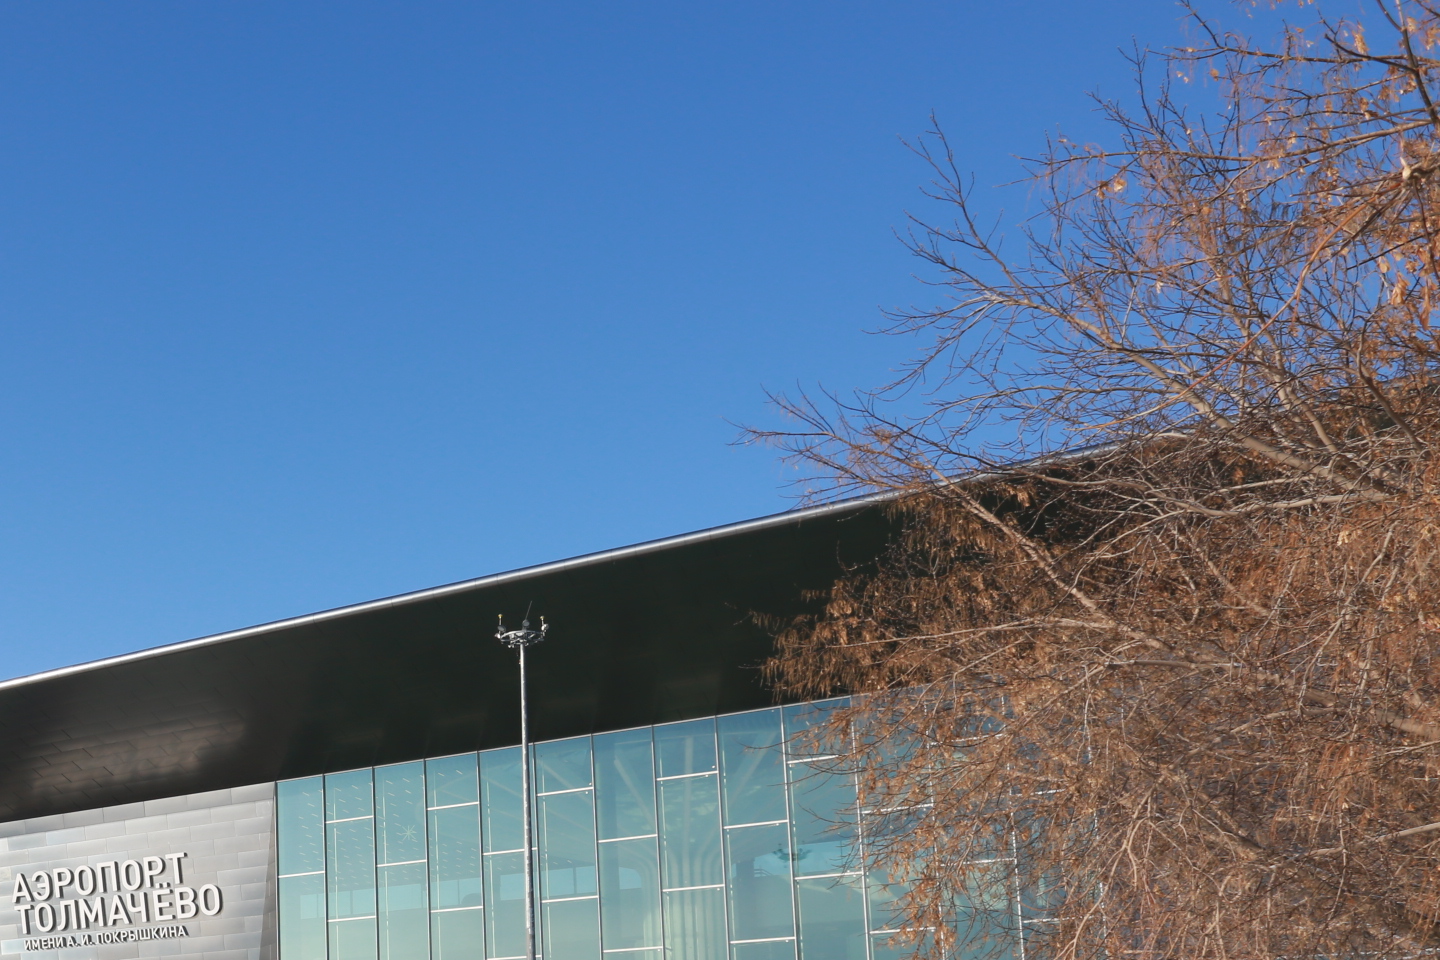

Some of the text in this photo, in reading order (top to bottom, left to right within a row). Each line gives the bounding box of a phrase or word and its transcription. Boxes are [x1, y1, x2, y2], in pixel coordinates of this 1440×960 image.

[12, 852, 187, 903] АЭРОПОРТ
[14, 882, 223, 934] ТОЛМАЧЁВО
[23, 925, 190, 951] ИМЕНИ А. И. ПОКРЫШКИНА
